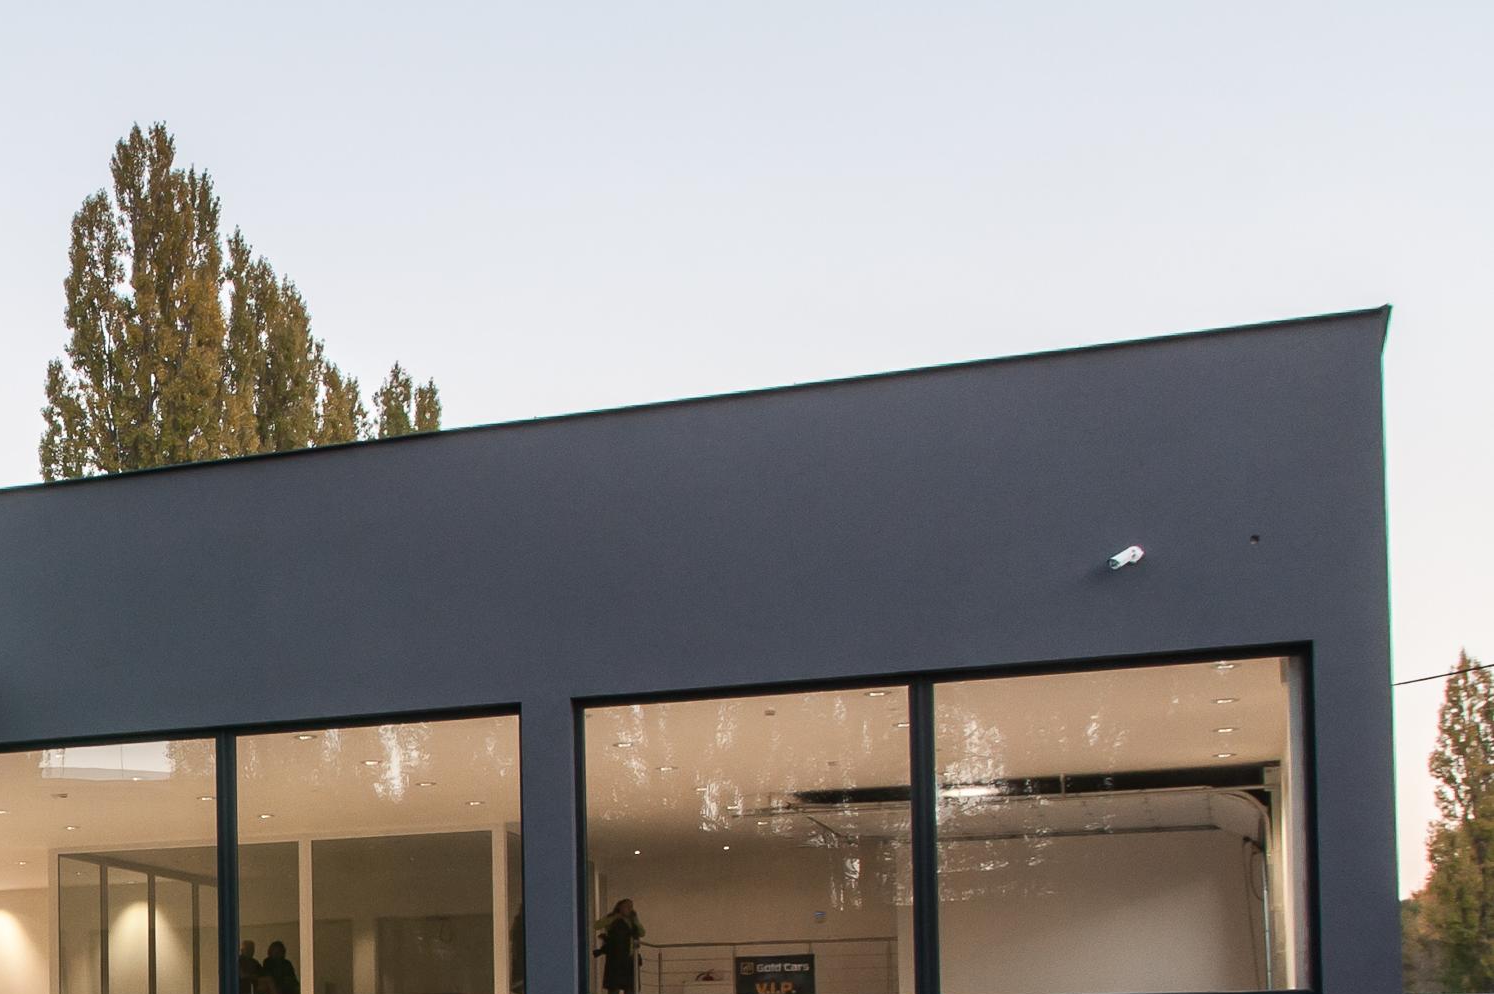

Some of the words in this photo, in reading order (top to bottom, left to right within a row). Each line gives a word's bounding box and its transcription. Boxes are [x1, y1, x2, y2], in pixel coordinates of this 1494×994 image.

[756, 963, 782, 972] Gold
[784, 962, 810, 972] Cars
[755, 981, 797, 994] V.I.P.
